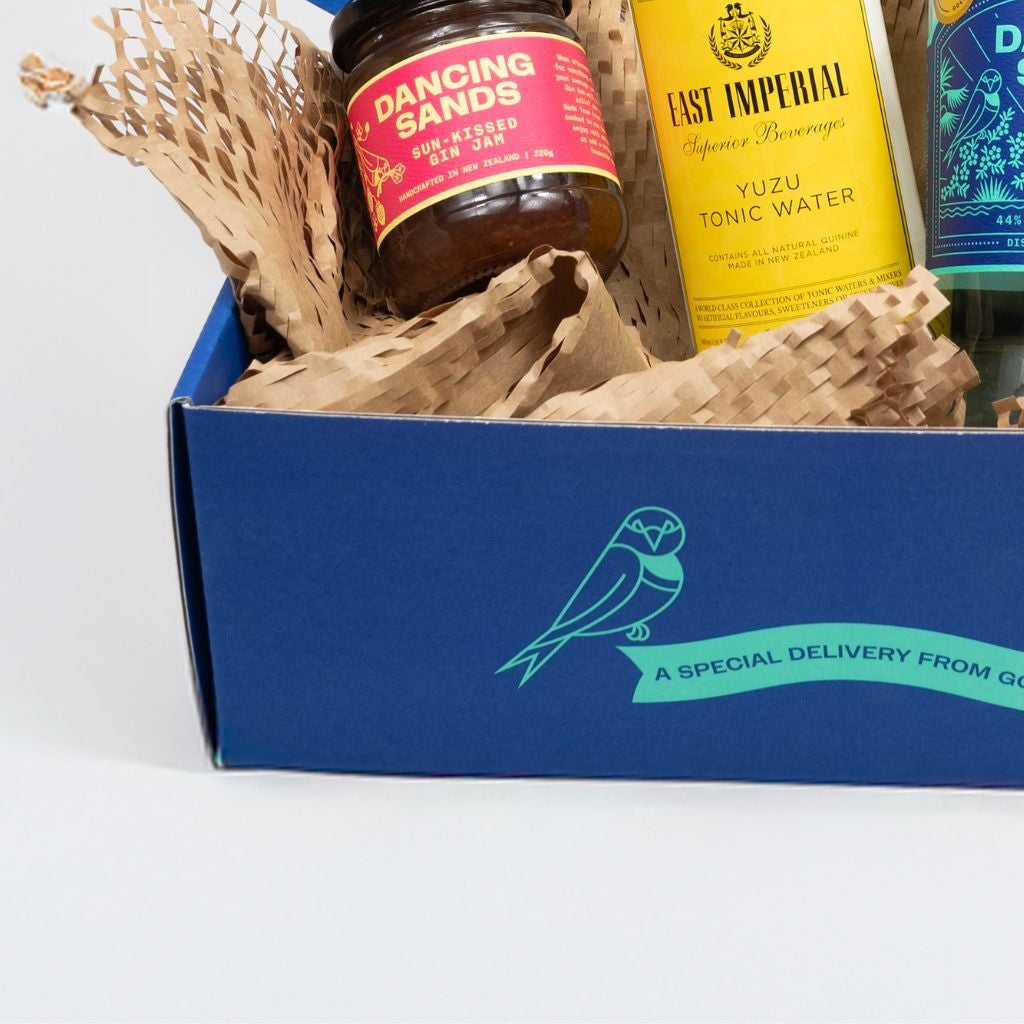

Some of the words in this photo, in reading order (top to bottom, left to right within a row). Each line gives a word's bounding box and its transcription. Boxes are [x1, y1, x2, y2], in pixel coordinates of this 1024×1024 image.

[373, 52, 536, 124] DANCING
[667, 86, 714, 127] EAST
[724, 62, 849, 118] IMPERIAL
[396, 81, 522, 140] SANDS
[411, 116, 519, 160] SUN-KISSED
[429, 145, 460, 167] GIN
[472, 133, 506, 152] JAM
[682, 132, 751, 162] Superior
[753, 116, 846, 146] Beverages
[398, 175, 445, 203] HANDCRAFTED
[448, 169, 459, 179] IN
[462, 162, 479, 173] NEW
[483, 153, 520, 167] ZEALAND
[736, 173, 801, 199] YUZU
[699, 205, 763, 228] TONIC
[772, 187, 855, 218] WATER
[995, 214, 1022, 226] 44%
[708, 250, 750, 263] CONTAINS
[752, 247, 769, 257] ALL
[772, 239, 818, 254] NATURAL
[820, 229, 860, 244] QUININE
[728, 260, 752, 270] MADE
[755, 258, 765, 266] IN
[768, 254, 790, 265] NEW
[794, 244, 840, 260] ZEALAND
[740, 295, 792, 310] COLLECTION
[793, 293, 804, 302] OF
[807, 288, 833, 299] TONIC
[835, 278, 868, 293] WATERS
[876, 269, 902, 284] MIXERS
[777, 297, 834, 314] SWEETENERS
[655, 666, 672, 681] A
[677, 650, 783, 679] SPECIAL
[788, 644, 912, 663] DELIVERY
[917, 651, 992, 680] FROM
